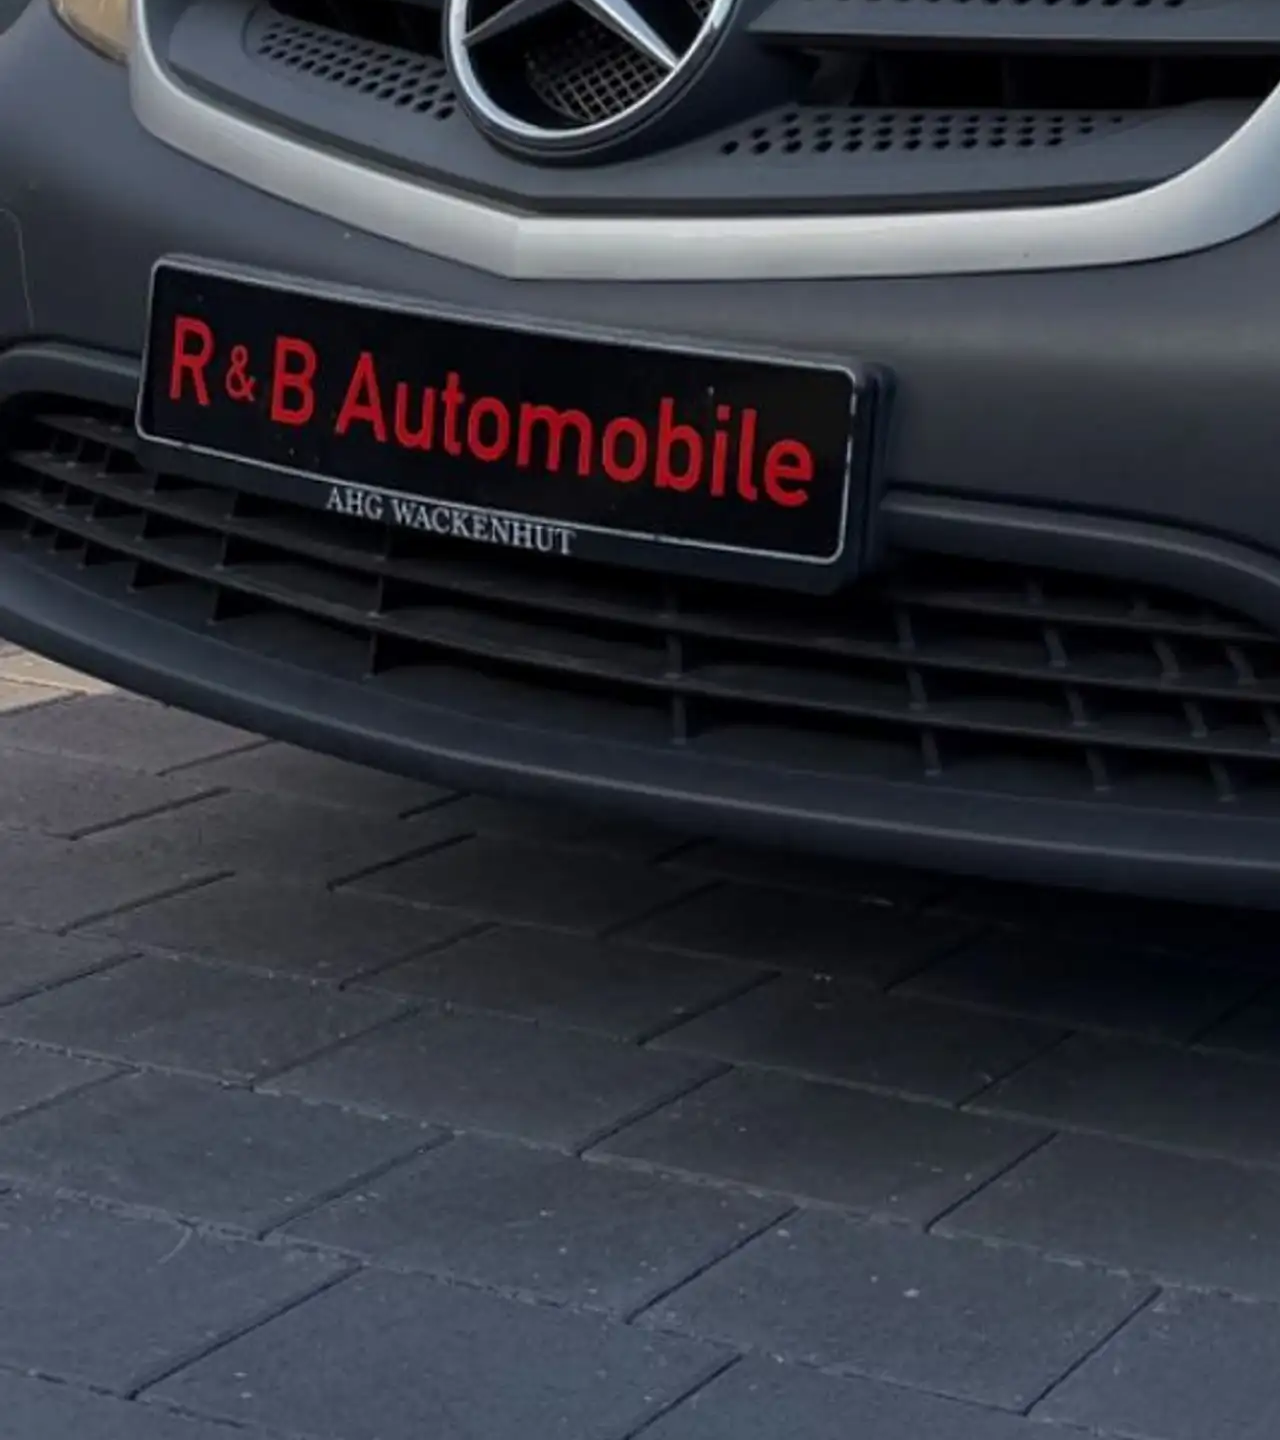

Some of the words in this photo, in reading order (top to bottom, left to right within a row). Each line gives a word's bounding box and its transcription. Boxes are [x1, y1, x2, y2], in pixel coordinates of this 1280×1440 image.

[169, 314, 213, 406] R
[225, 344, 255, 402] &
[270, 335, 317, 426] B
[334, 351, 815, 507] Automobile
[326, 485, 383, 520] AHG
[391, 498, 577, 556] WACKENHUT
